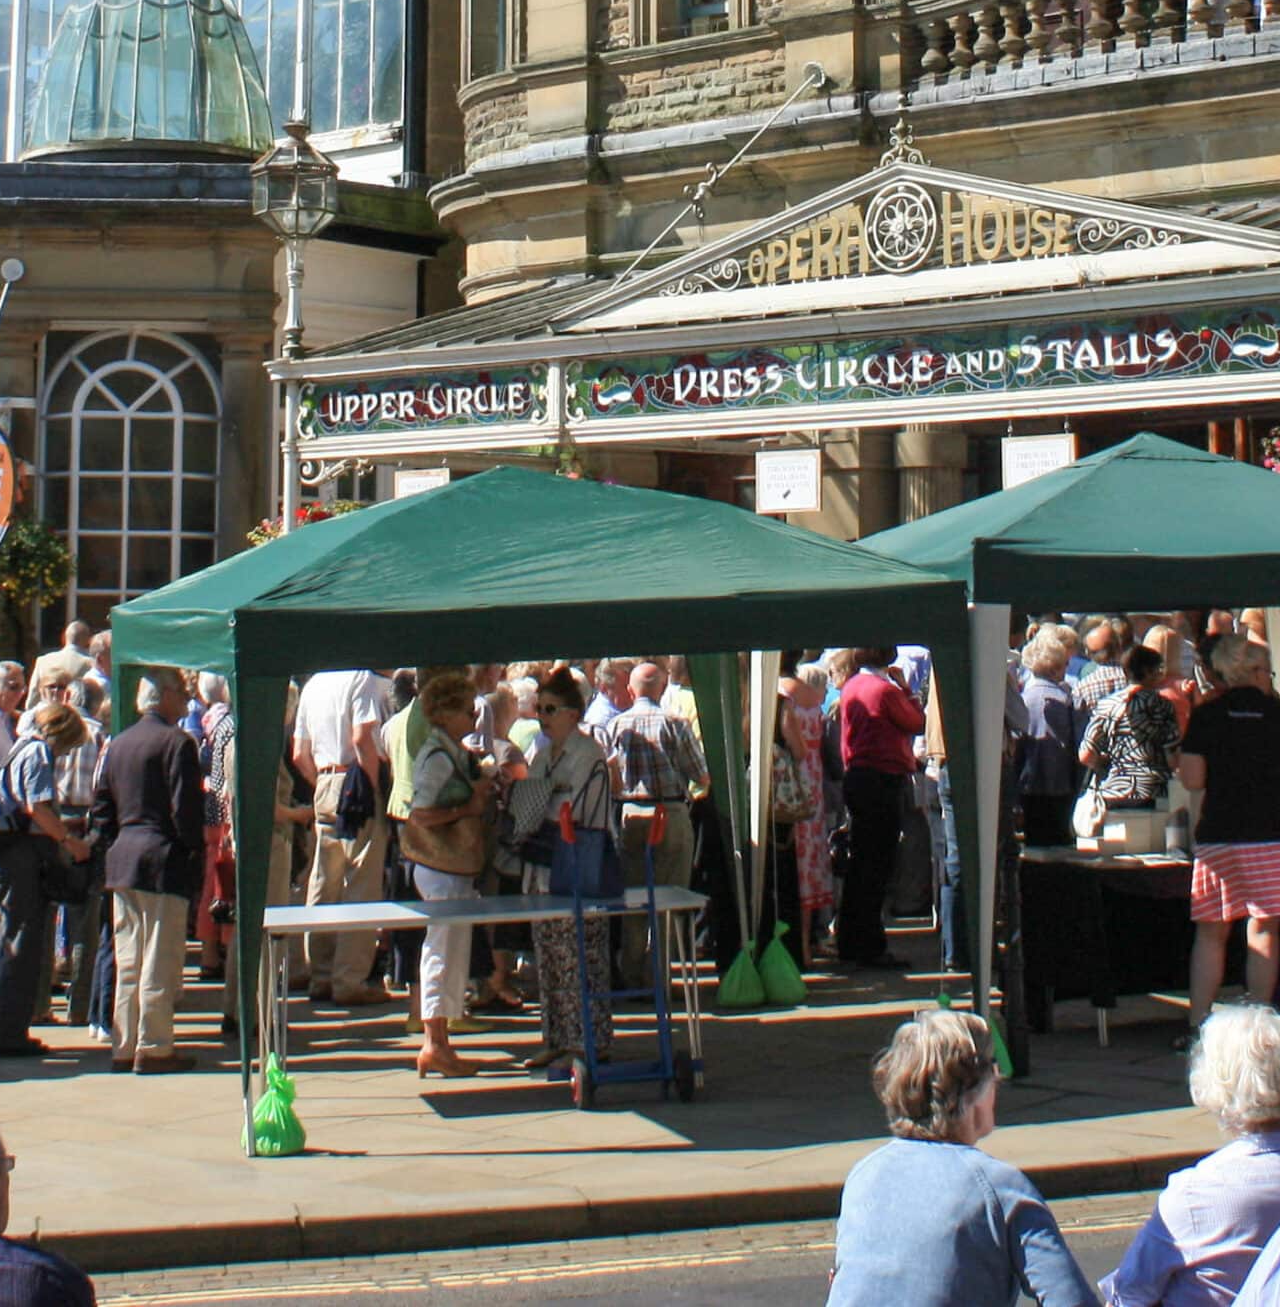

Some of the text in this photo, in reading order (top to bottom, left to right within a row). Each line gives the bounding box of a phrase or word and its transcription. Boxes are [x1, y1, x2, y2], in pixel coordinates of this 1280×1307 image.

[747, 191, 1074, 285] OPERA HOUSE
[673, 326, 1179, 398] DRESS CIRCLE AND STALLS
[328, 382, 528, 424] UPPER CIRCLE
